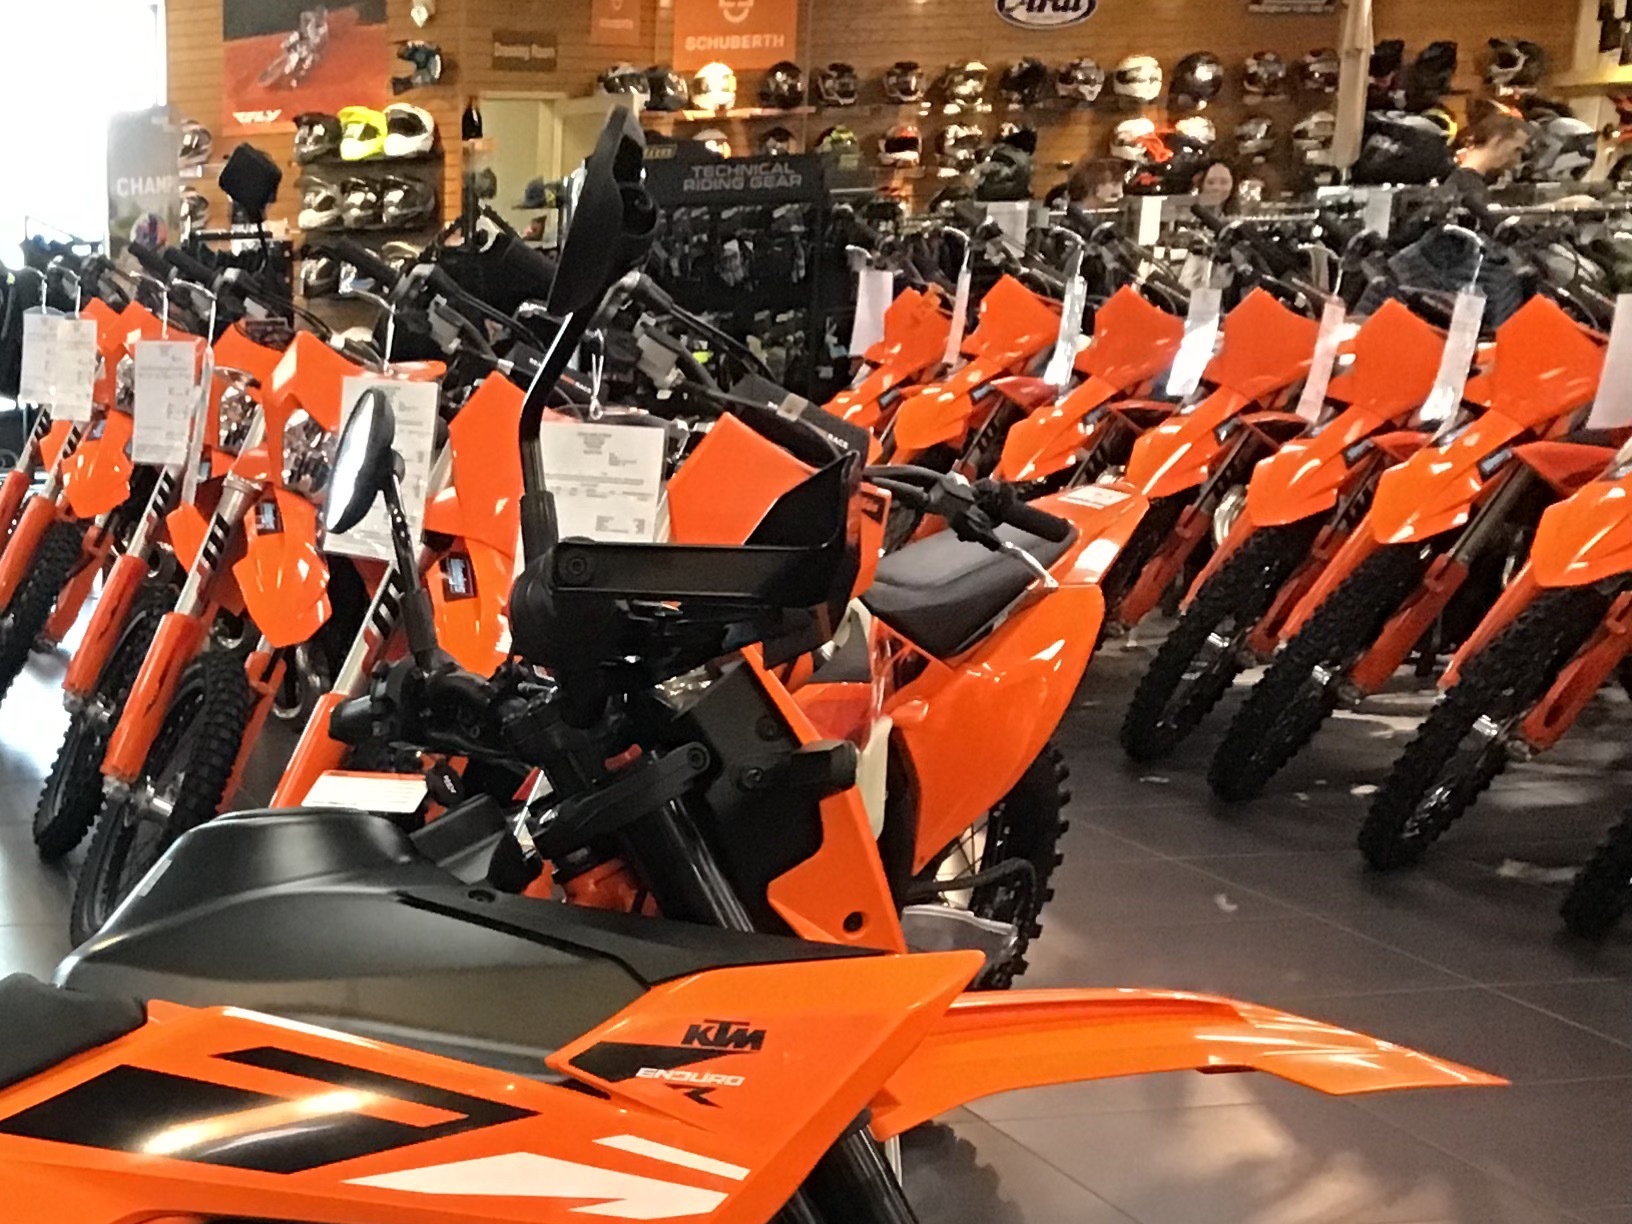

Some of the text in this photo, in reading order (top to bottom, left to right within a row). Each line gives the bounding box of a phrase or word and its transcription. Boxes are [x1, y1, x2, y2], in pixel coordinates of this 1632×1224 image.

[685, 34, 785, 51] SCHUBERTH
[691, 162, 796, 179] TECHNICAL
[682, 174, 802, 192] RIDING GEAR
[680, 1018, 767, 1051] KTM
[635, 1067, 746, 1086] ENDURO
